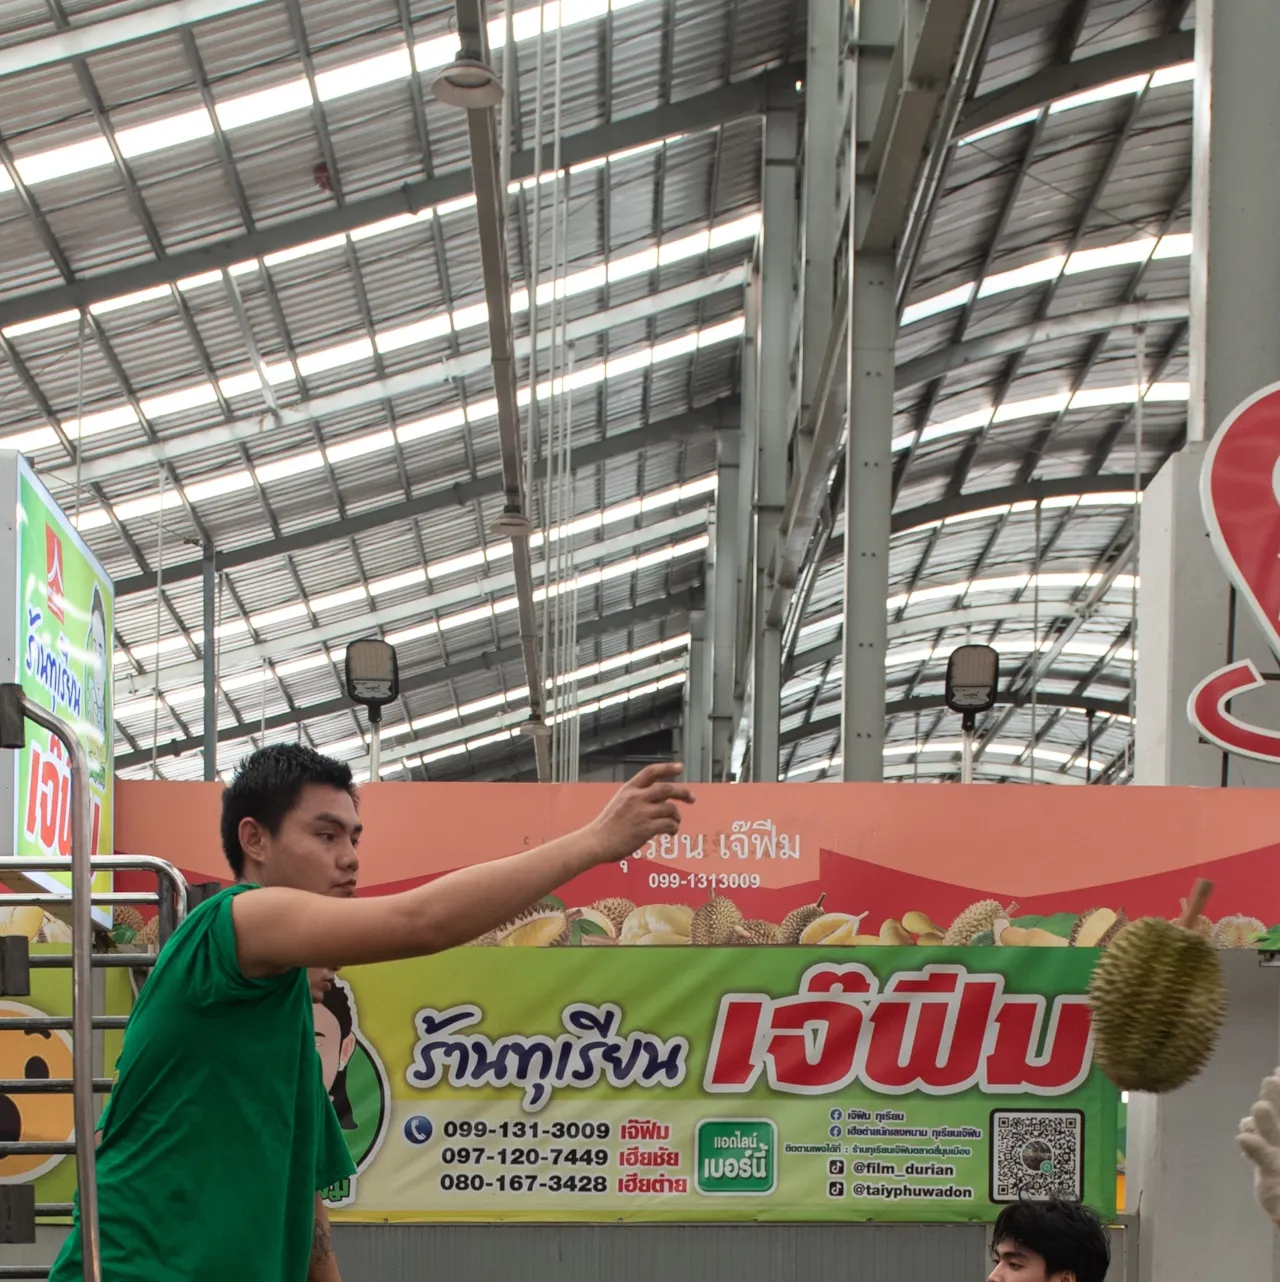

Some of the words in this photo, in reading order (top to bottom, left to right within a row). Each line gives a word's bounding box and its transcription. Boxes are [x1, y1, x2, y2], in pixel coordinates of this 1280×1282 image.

[721, 818, 801, 859] เจ๊ฟีม
[648, 873, 760, 889] 099-1313009
[412, 1009, 682, 1106] ร้านทุเรียน
[710, 970, 1093, 1088] เจ๊ฟีม
[876, 1111, 904, 1123] ทุเรียน
[443, 1121, 611, 1140] 099-131-3009
[620, 1119, 670, 1140] เจ๊ฟีม
[713, 1131, 758, 1149] แอดไลน์
[441, 1148, 609, 1167] 097-120-7449
[619, 1149, 680, 1167] เฮียชัย
[704, 1145, 768, 1179] เบอร์นี้
[852, 1161, 955, 1177] @film_durian
[440, 1174, 608, 1193] 080-167-3428
[617, 1175, 688, 1195] เฮียต่าย
[852, 1183, 973, 1199] @taiyphuwadon
